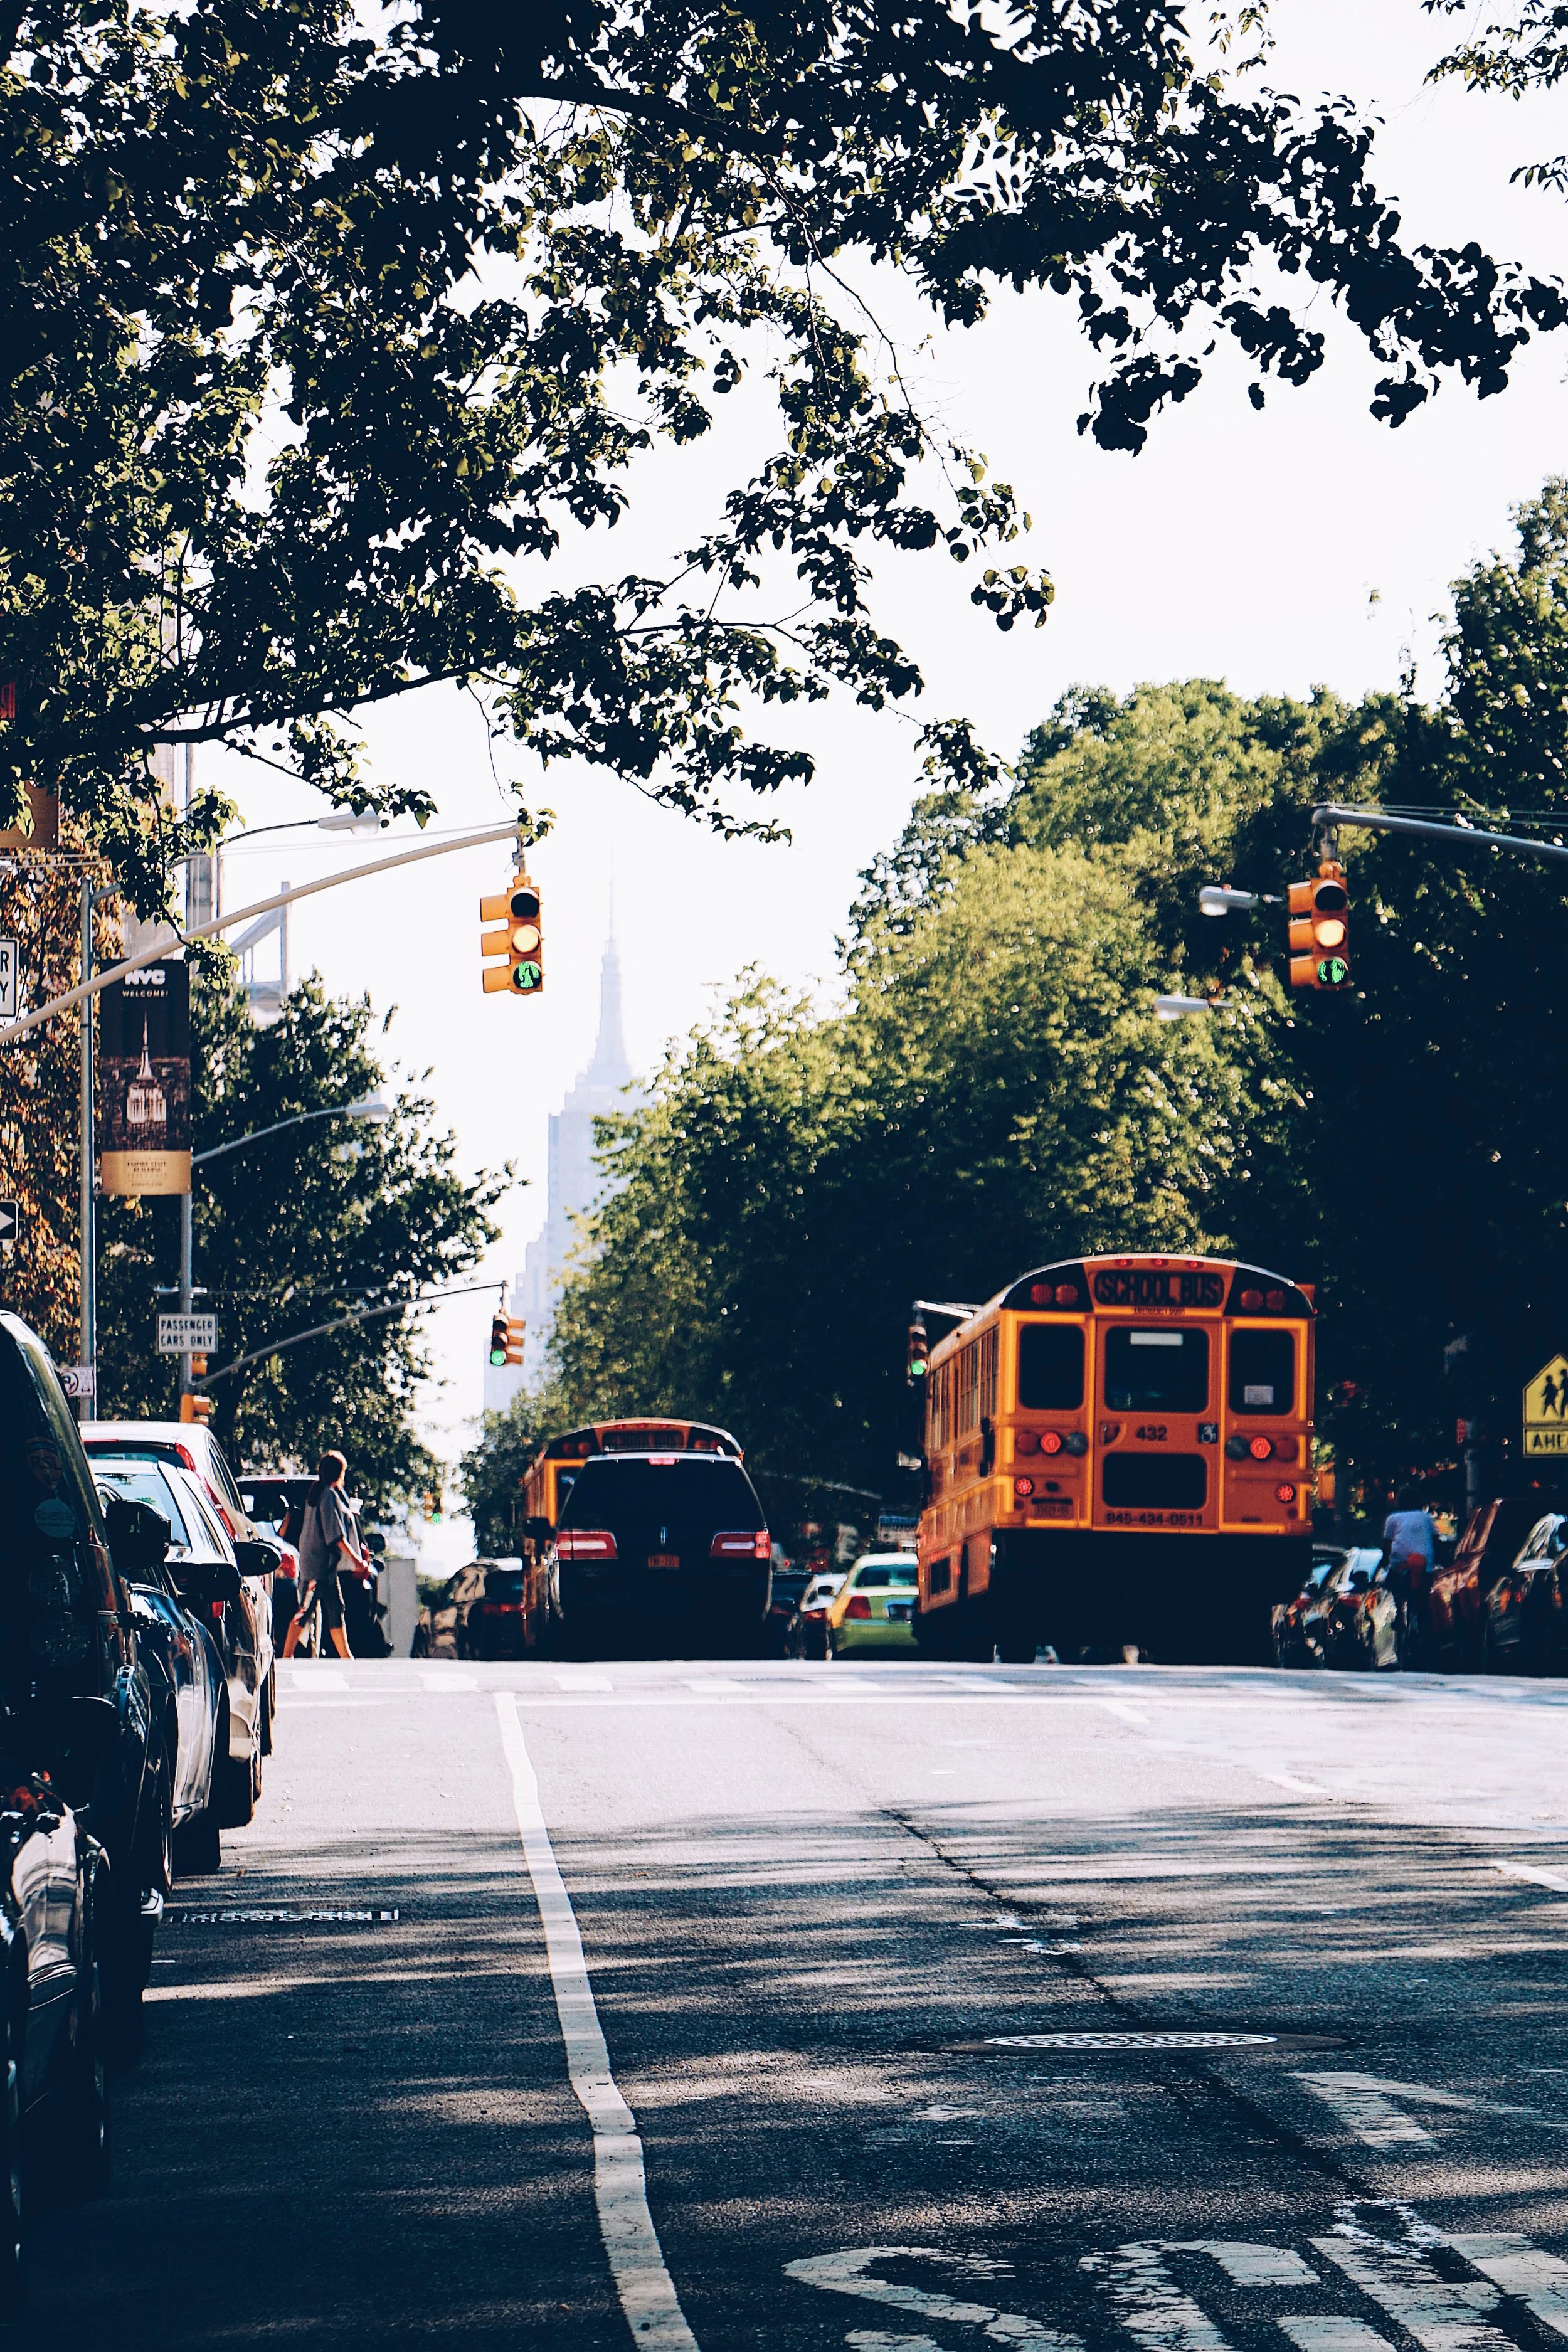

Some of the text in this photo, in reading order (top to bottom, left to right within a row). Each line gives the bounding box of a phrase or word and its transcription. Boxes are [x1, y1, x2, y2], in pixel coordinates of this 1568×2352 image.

[125, 969, 166, 985] NYC
[1101, 1274, 1221, 1306] SCHOOL BUS
[161, 1319, 213, 1331] PASSENGER
[161, 1335, 213, 1347] CARS ONLY
[1136, 1424, 1167, 1441] 432
[1106, 1512, 1202, 1526] 845-434-0511
